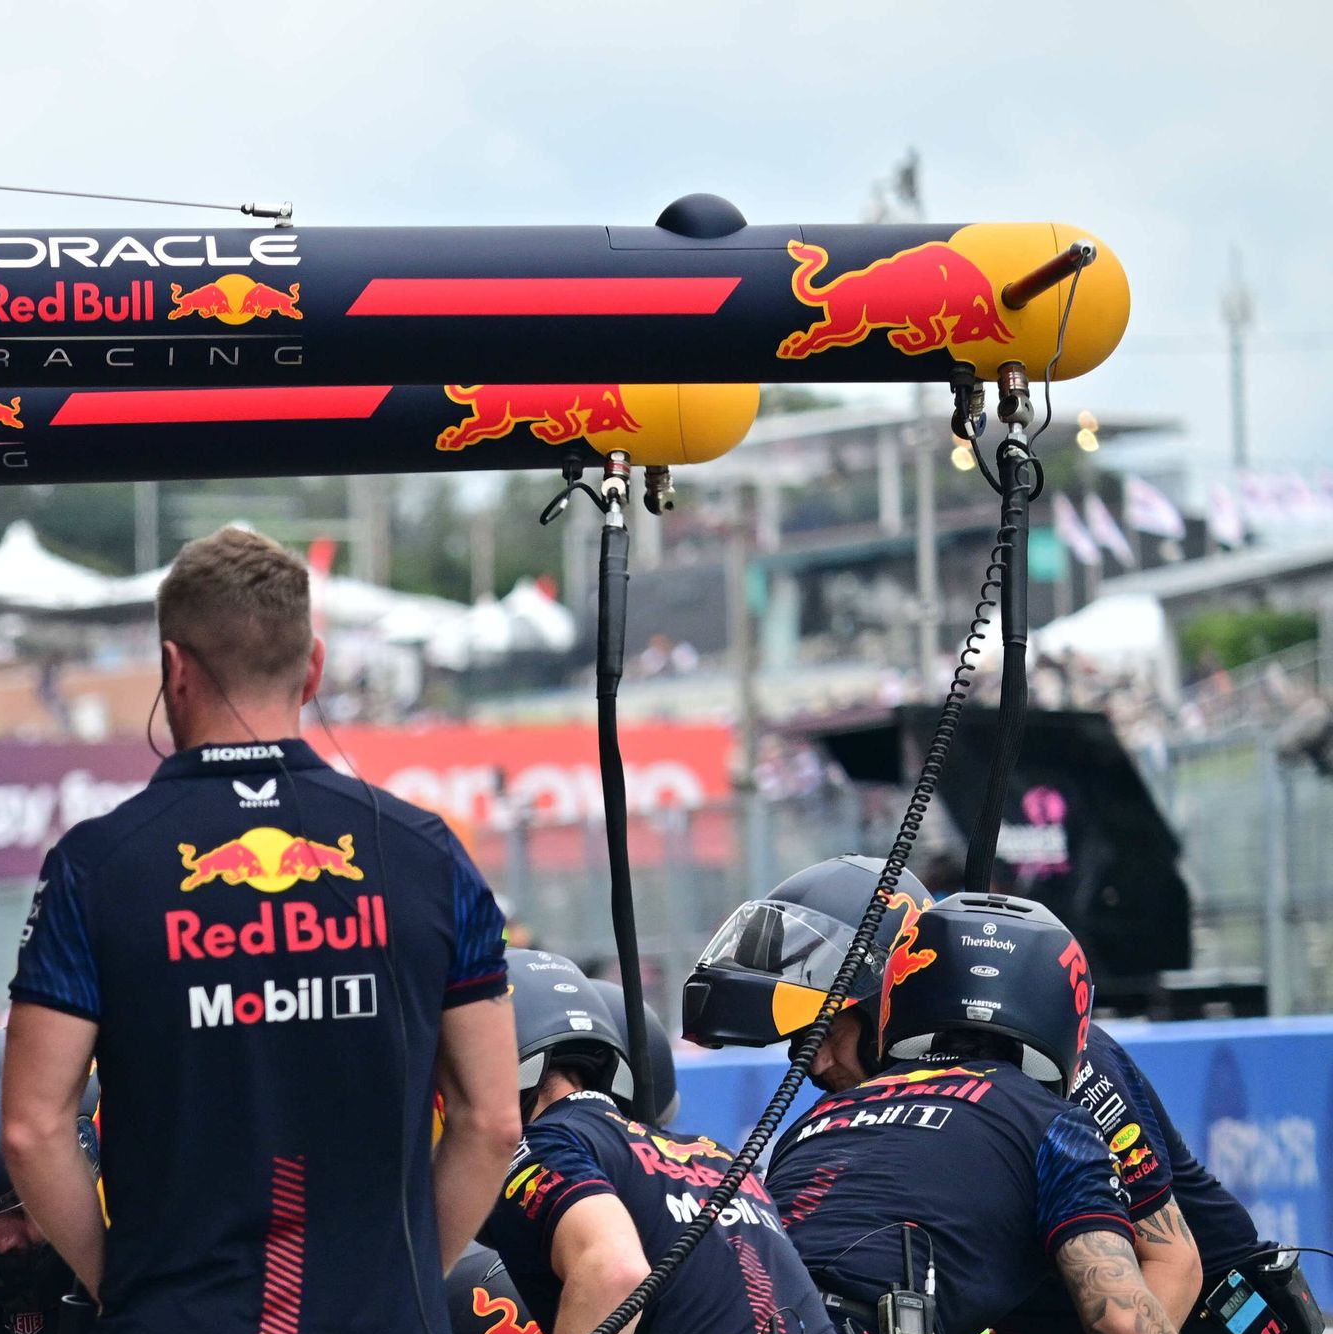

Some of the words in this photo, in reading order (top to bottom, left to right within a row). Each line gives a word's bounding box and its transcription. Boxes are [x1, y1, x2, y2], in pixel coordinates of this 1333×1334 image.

[74, 280, 154, 322] Bull
[201, 744, 285, 762] HONDA
[165, 901, 275, 961] Red
[283, 896, 387, 952] Bull
[961, 935, 1017, 953] Therabody
[189, 978, 323, 1028] Mobil
[1080, 1074, 1114, 1111] citrix
[1116, 1127, 1137, 1145] RAUCH
[1141, 1156, 1159, 1174] Bull
